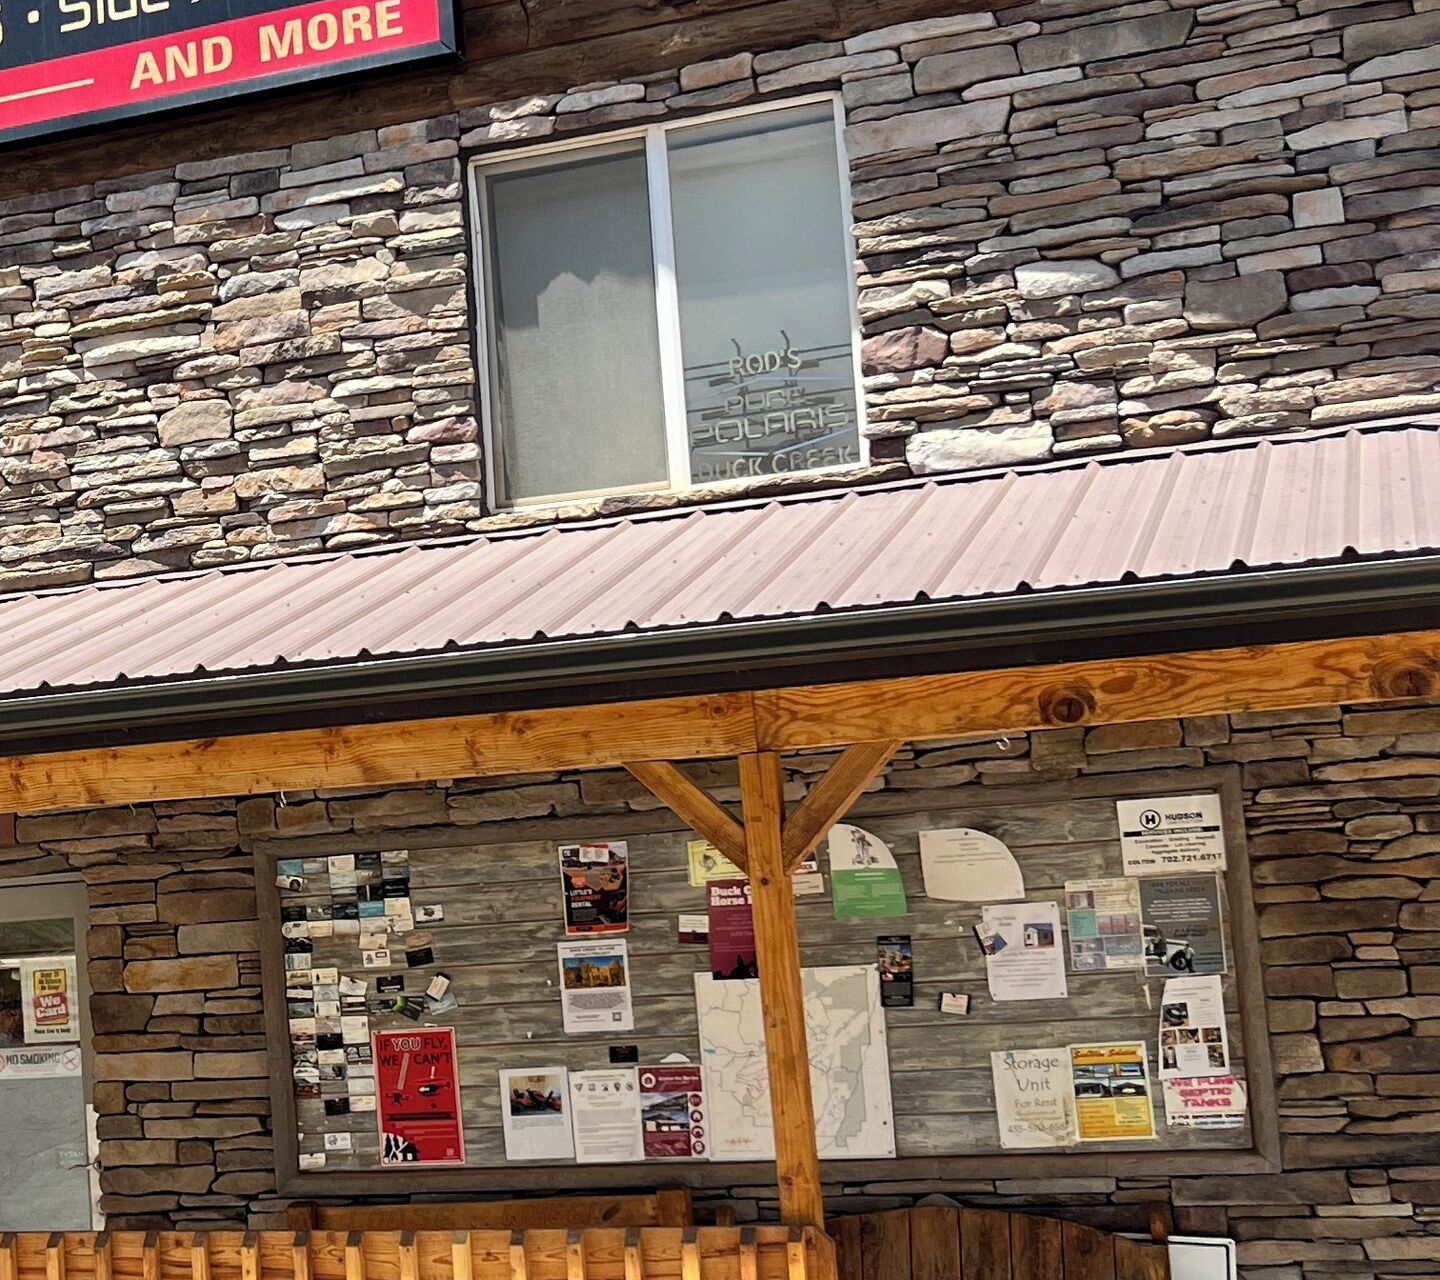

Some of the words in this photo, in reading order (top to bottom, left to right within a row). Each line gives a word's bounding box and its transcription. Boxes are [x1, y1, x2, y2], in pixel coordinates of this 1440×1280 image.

[129, 36, 233, 90] AND
[727, 347, 802, 377] ROD'S
[689, 403, 849, 450] POLARIS
[1165, 812, 1203, 820] HUDSON
[710, 886, 742, 897] Duck
[710, 896, 745, 906] Horse
[39, 996, 61, 1007] We
[36, 1005, 66, 1018] Card
[381, 1041, 391, 1051] IF
[392, 1037, 421, 1051] YOU
[6, 1054, 19, 1065] NO
[20, 1052, 61, 1065] SMOKING
[381, 1055, 400, 1066] WE
[414, 1052, 452, 1065] CAN'T
[1003, 1056, 1059, 1073] Storage
[1017, 1079, 1052, 1092] Unit
[1180, 1087, 1232, 1097] SEPTIC
[1034, 1098, 1057, 1108] Rent
[1182, 1098, 1232, 1107] TANKS
